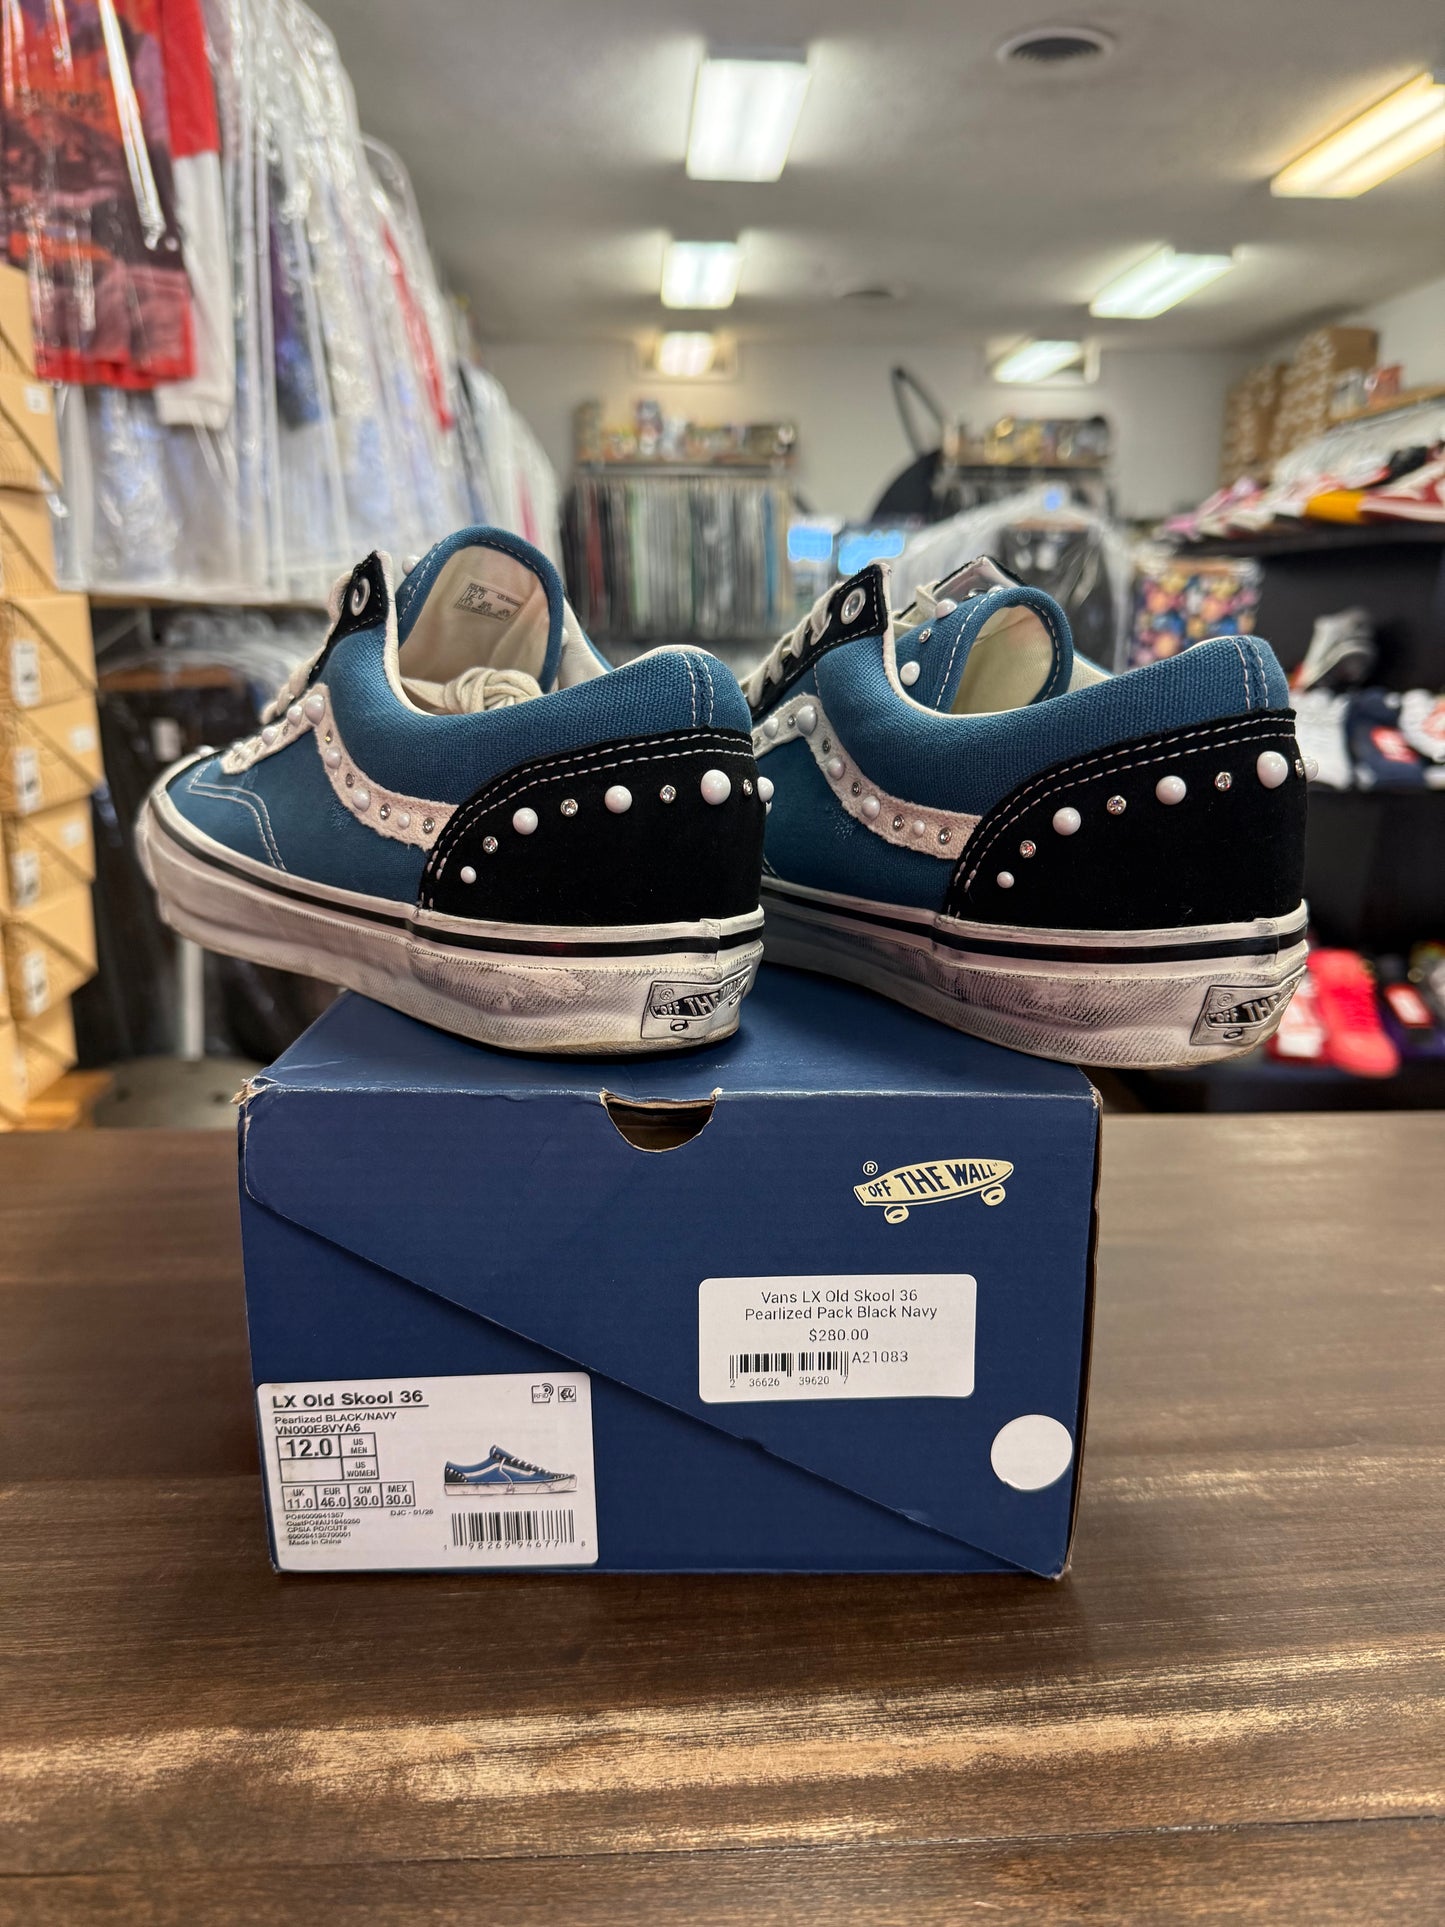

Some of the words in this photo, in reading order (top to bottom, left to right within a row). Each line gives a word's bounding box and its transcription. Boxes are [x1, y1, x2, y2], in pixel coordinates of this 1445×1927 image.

[894, 1166, 950, 1196] THE
[761, 1291, 797, 1304] Vans
[802, 1290, 821, 1303] LX
[825, 1289, 849, 1303] Old
[854, 1289, 895, 1302] Skool
[900, 1289, 918, 1302] 36
[745, 1306, 812, 1320] Pearlized
[817, 1306, 853, 1319] Pack
[857, 1305, 896, 1318] Black
[902, 1305, 938, 1320] Navy
[809, 1328, 869, 1342] $280.00
[852, 1351, 909, 1364] A21083
[729, 1379, 736, 1388] 2
[749, 1377, 780, 1387] 36626
[799, 1375, 830, 1386] 39620
[842, 1375, 849, 1385] 7
[272, 1395, 298, 1409] LX
[303, 1393, 334, 1407] Old
[341, 1391, 394, 1406] Skool
[400, 1390, 424, 1403] 36
[274, 1414, 322, 1425] Pearlized
[325, 1412, 397, 1423] BLACK/NAVY
[275, 1423, 361, 1435] VN000E8VYA6
[353, 1438, 364, 1446] US
[286, 1438, 333, 1458] 12.0
[355, 1461, 366, 1469] US
[346, 1470, 376, 1478] WOMEN
[324, 1487, 341, 1495] EUR
[358, 1486, 372, 1494] CM
[388, 1485, 408, 1493] MEX
[287, 1498, 314, 1509] 11.0
[320, 1497, 346, 1508] 46.0
[353, 1495, 379, 1506] 30.0
[386, 1494, 412, 1505] 30.0
